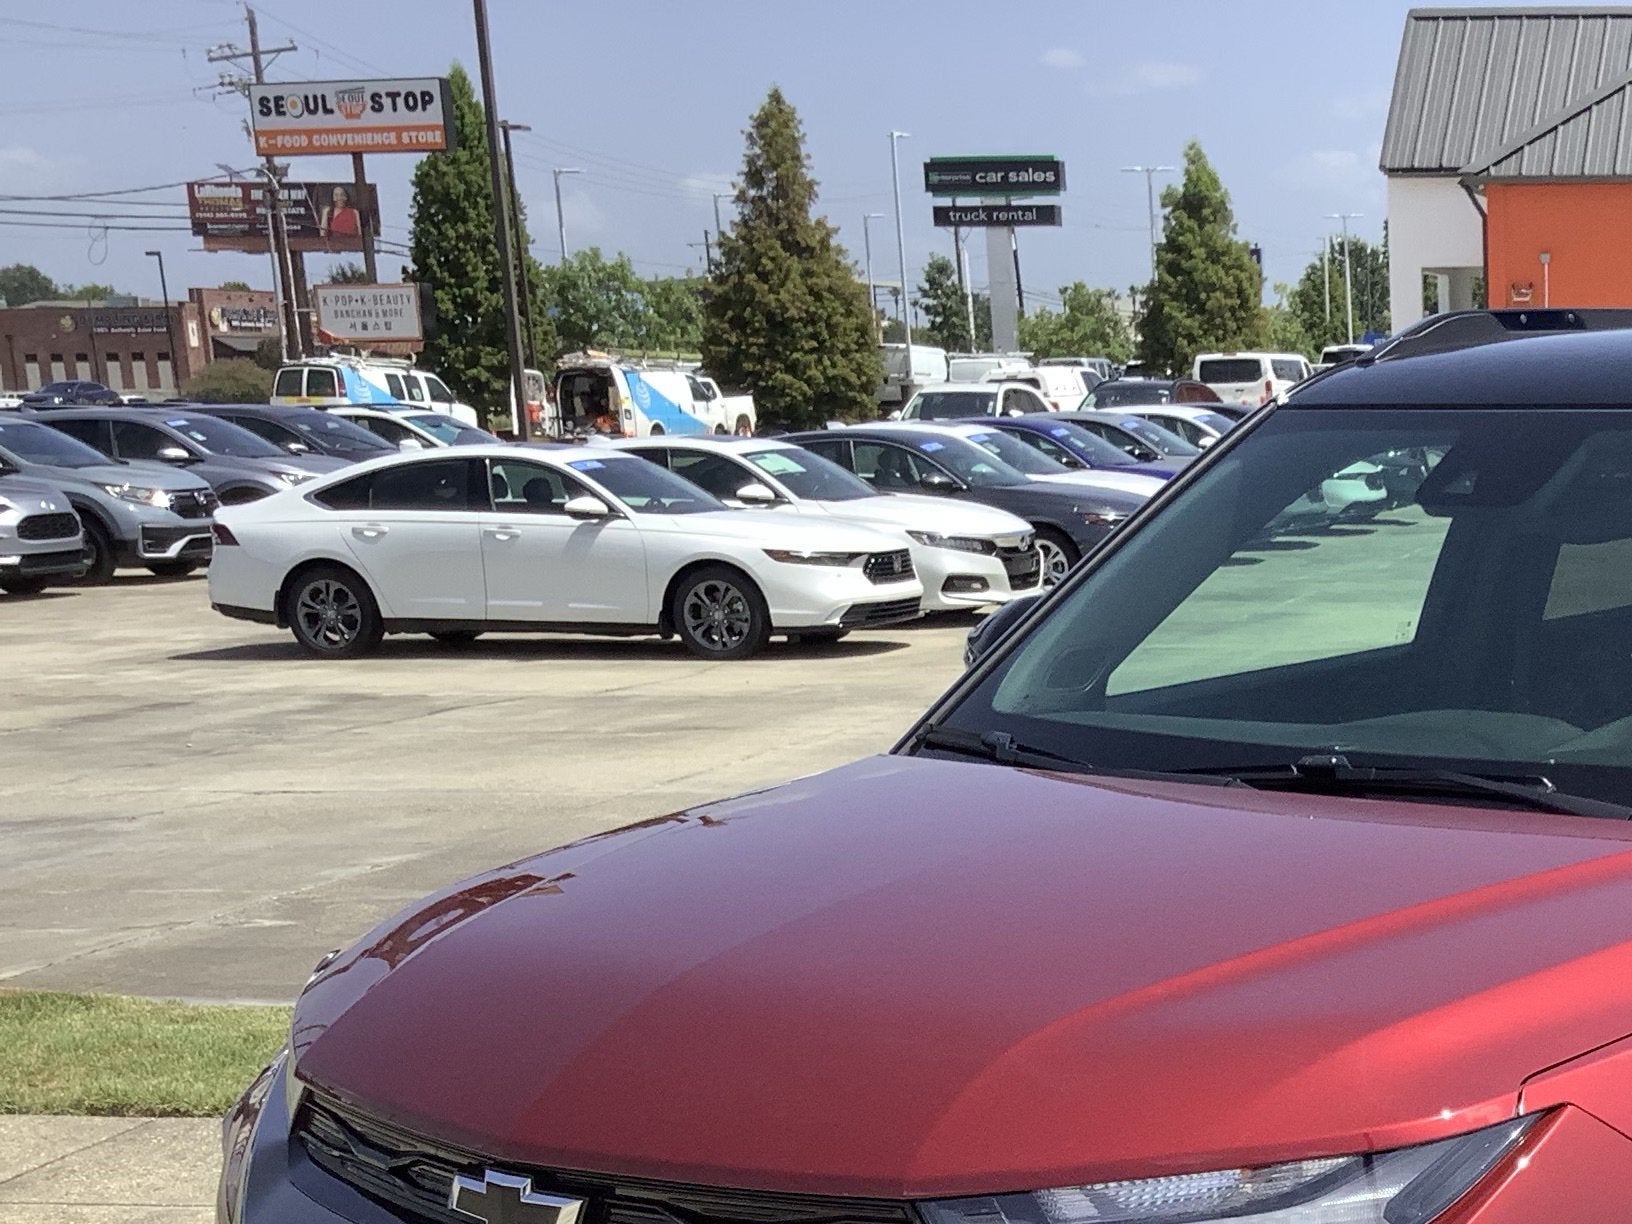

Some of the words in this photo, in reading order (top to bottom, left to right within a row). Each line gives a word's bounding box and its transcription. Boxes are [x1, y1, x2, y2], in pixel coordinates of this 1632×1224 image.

[258, 93, 335, 118] SEOUL
[370, 91, 435, 113] STOP
[258, 135, 308, 149] K-FOOD
[312, 131, 397, 147] CONVENIENCE
[401, 129, 442, 144] STORE
[975, 171, 1005, 183] car
[1008, 168, 1056, 183] sales
[949, 208, 988, 222] truck
[993, 207, 1037, 221] rental
[333, 308, 373, 319] BANCHAN
[381, 308, 403, 318] MORE
